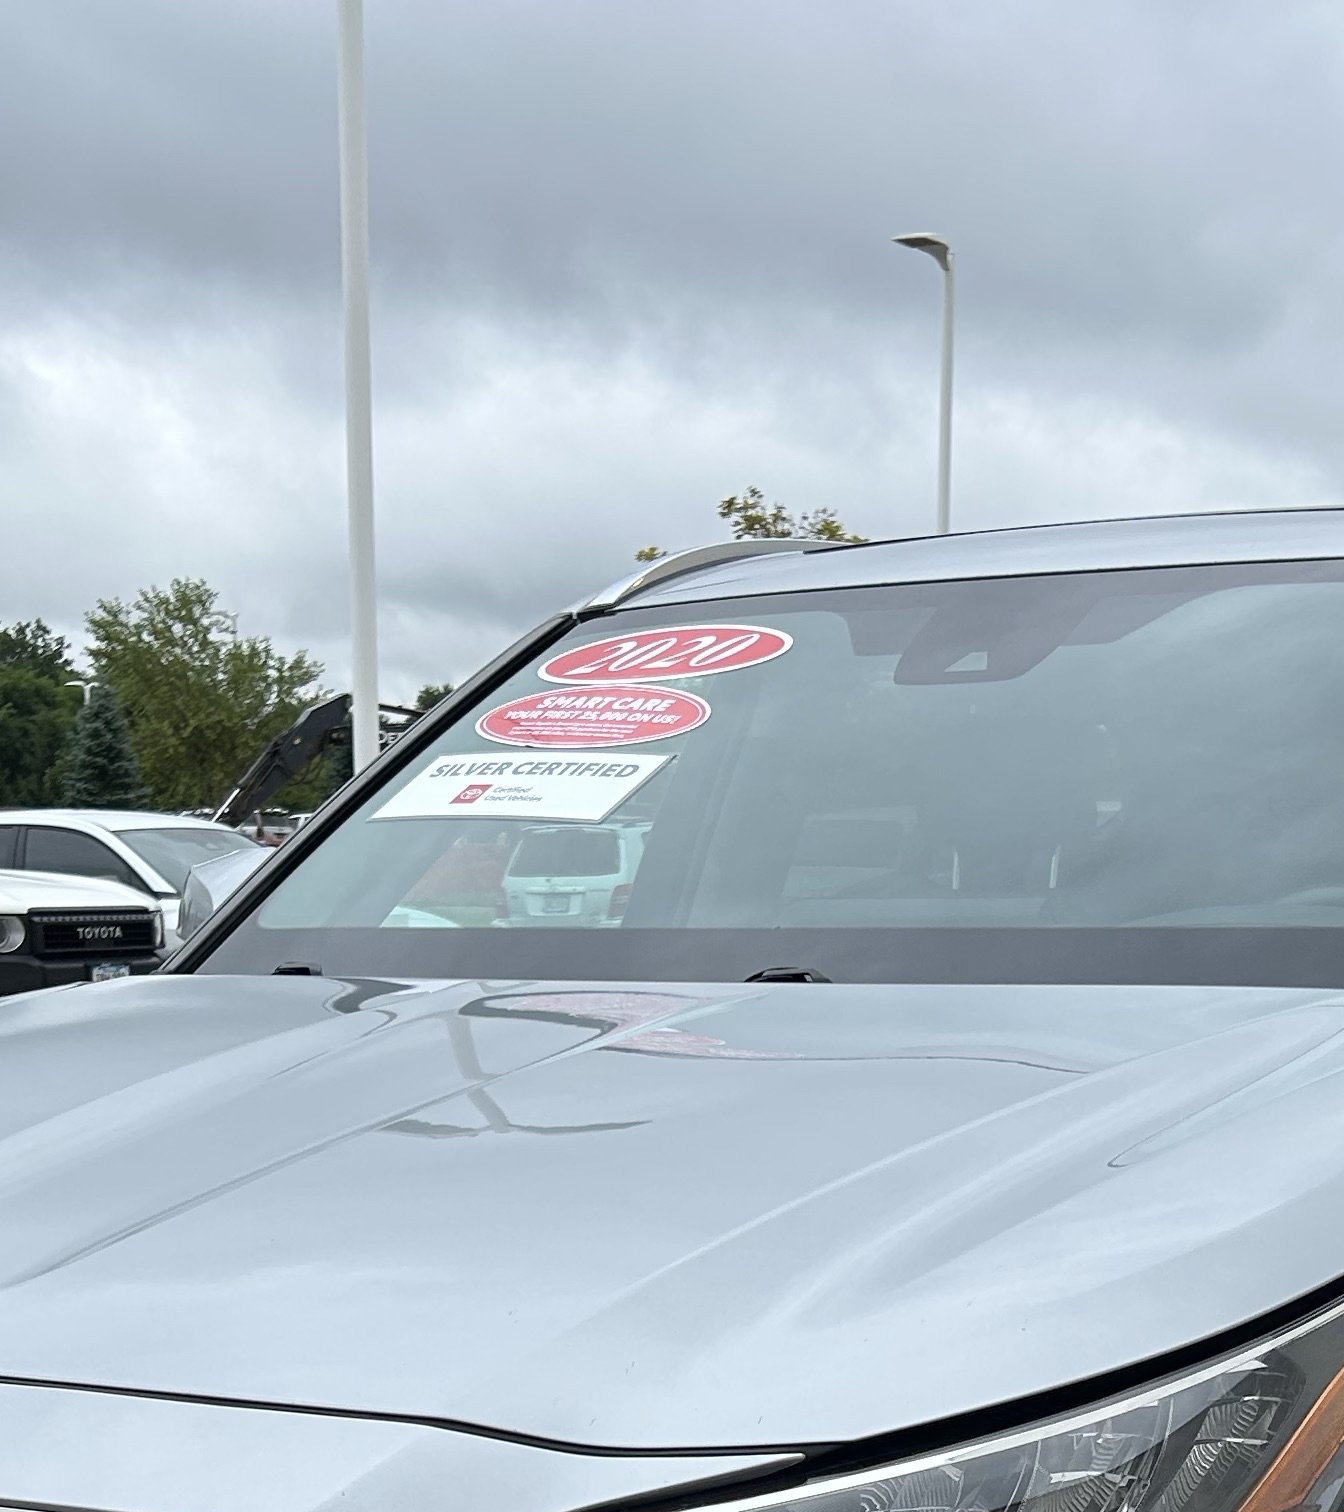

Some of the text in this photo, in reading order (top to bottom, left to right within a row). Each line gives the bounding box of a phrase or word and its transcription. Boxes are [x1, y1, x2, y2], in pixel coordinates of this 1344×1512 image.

[562, 633, 761, 676] 2020
[536, 696, 676, 712] SMART CARE
[504, 711, 544, 720] YOUR
[540, 711, 580, 720] FIRST
[627, 713, 655, 723] ON
[429, 761, 640, 778] SILVER CERTIFIED
[76, 926, 123, 939] TOYOTA
